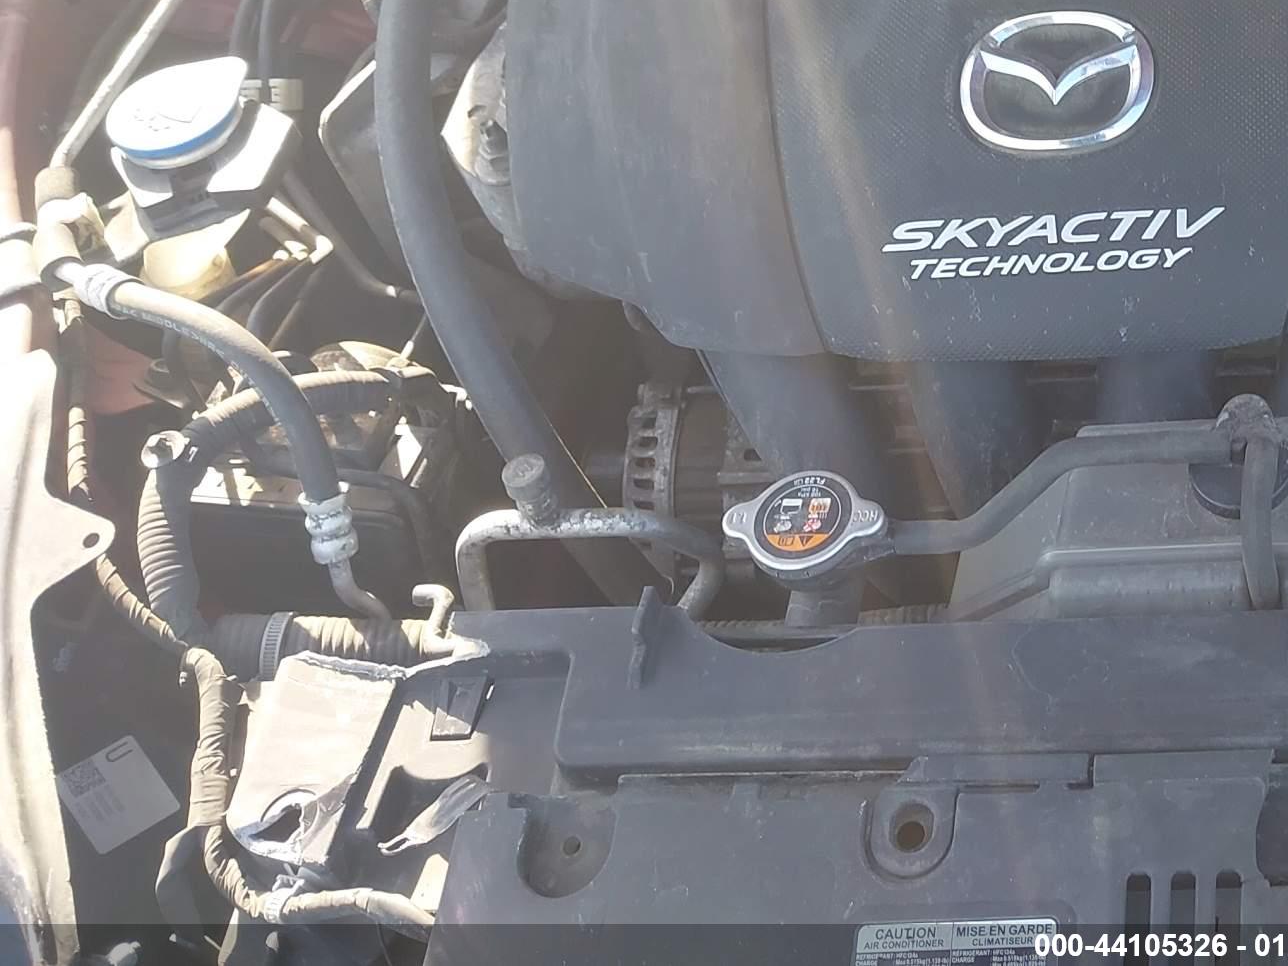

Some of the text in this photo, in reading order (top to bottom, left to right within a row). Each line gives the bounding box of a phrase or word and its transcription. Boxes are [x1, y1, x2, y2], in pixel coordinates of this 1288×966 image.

[882, 206, 1225, 253] SKYACTIV
[911, 247, 1193, 280] TECHNOLOGY
[875, 927, 936, 940] CAUTION
[956, 923, 1053, 937] MISE EN GARDE
[863, 938, 944, 950] AIR CONDITIONER
[972, 936, 1034, 947] CLIMATISEUR
